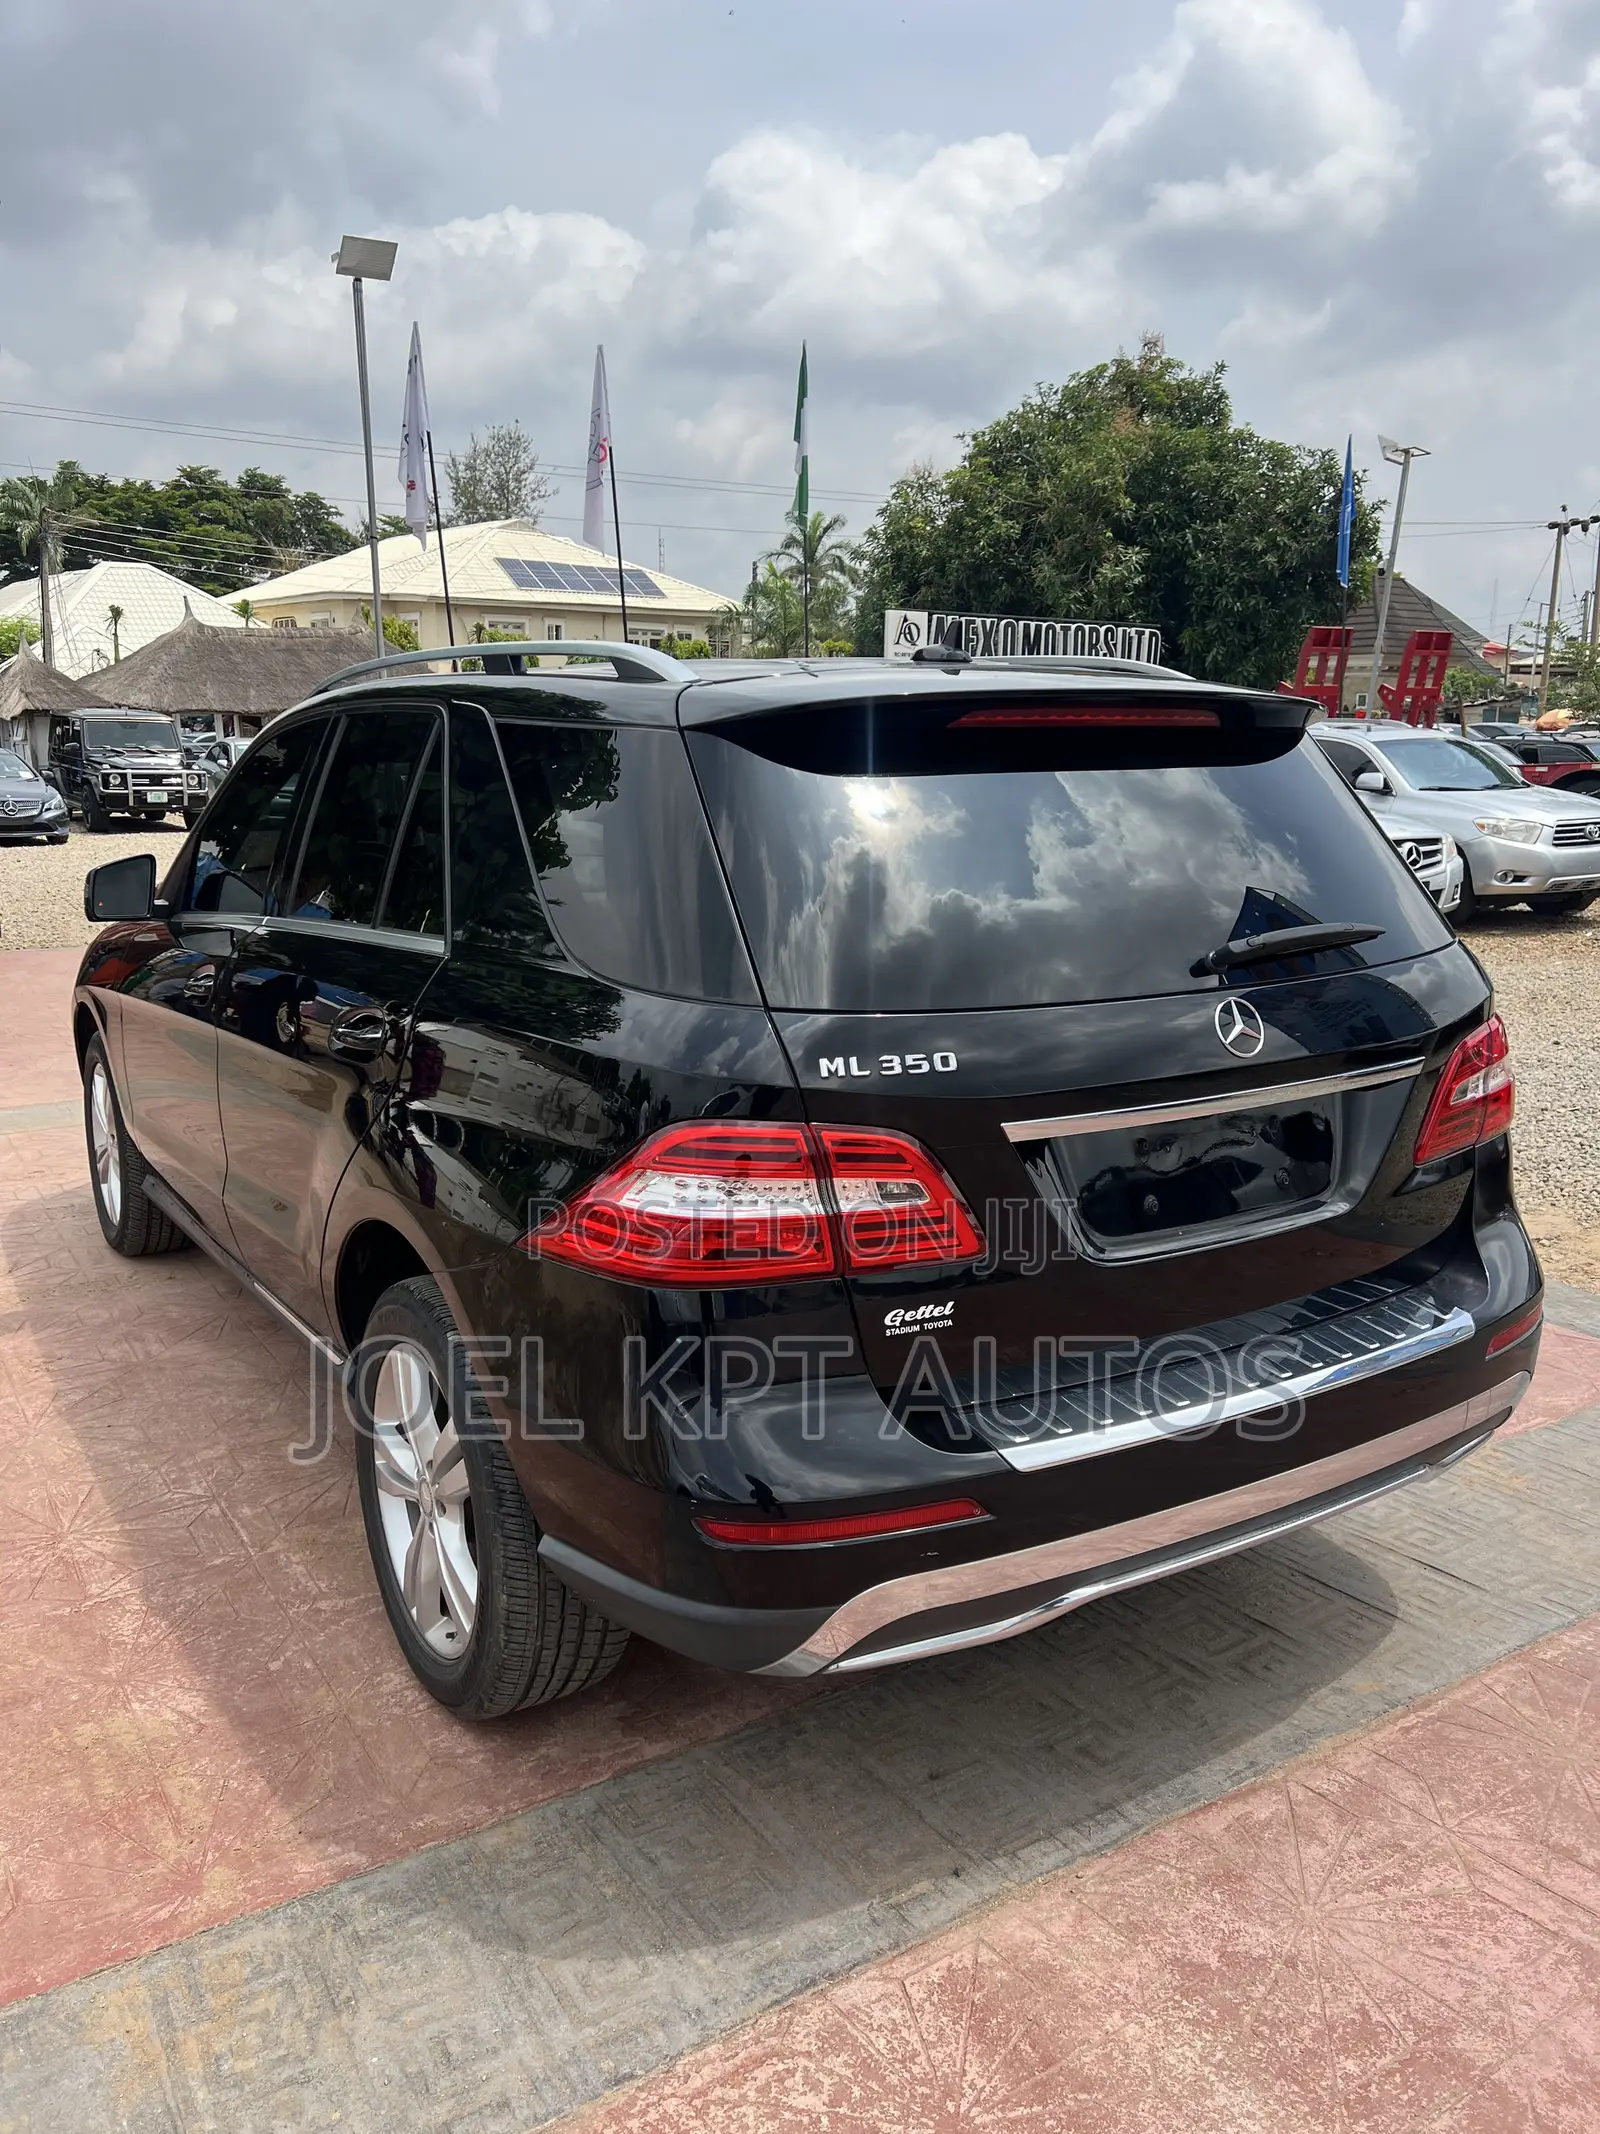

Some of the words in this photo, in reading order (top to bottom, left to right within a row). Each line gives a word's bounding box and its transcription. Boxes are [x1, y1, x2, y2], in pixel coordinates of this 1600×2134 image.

[818, 1056, 871, 1078] ML
[878, 1051, 958, 1076] 350
[884, 1301, 955, 1326] Gettel
[885, 1325, 920, 1336] STADIUM
[923, 1320, 953, 1330] TOYOTA
